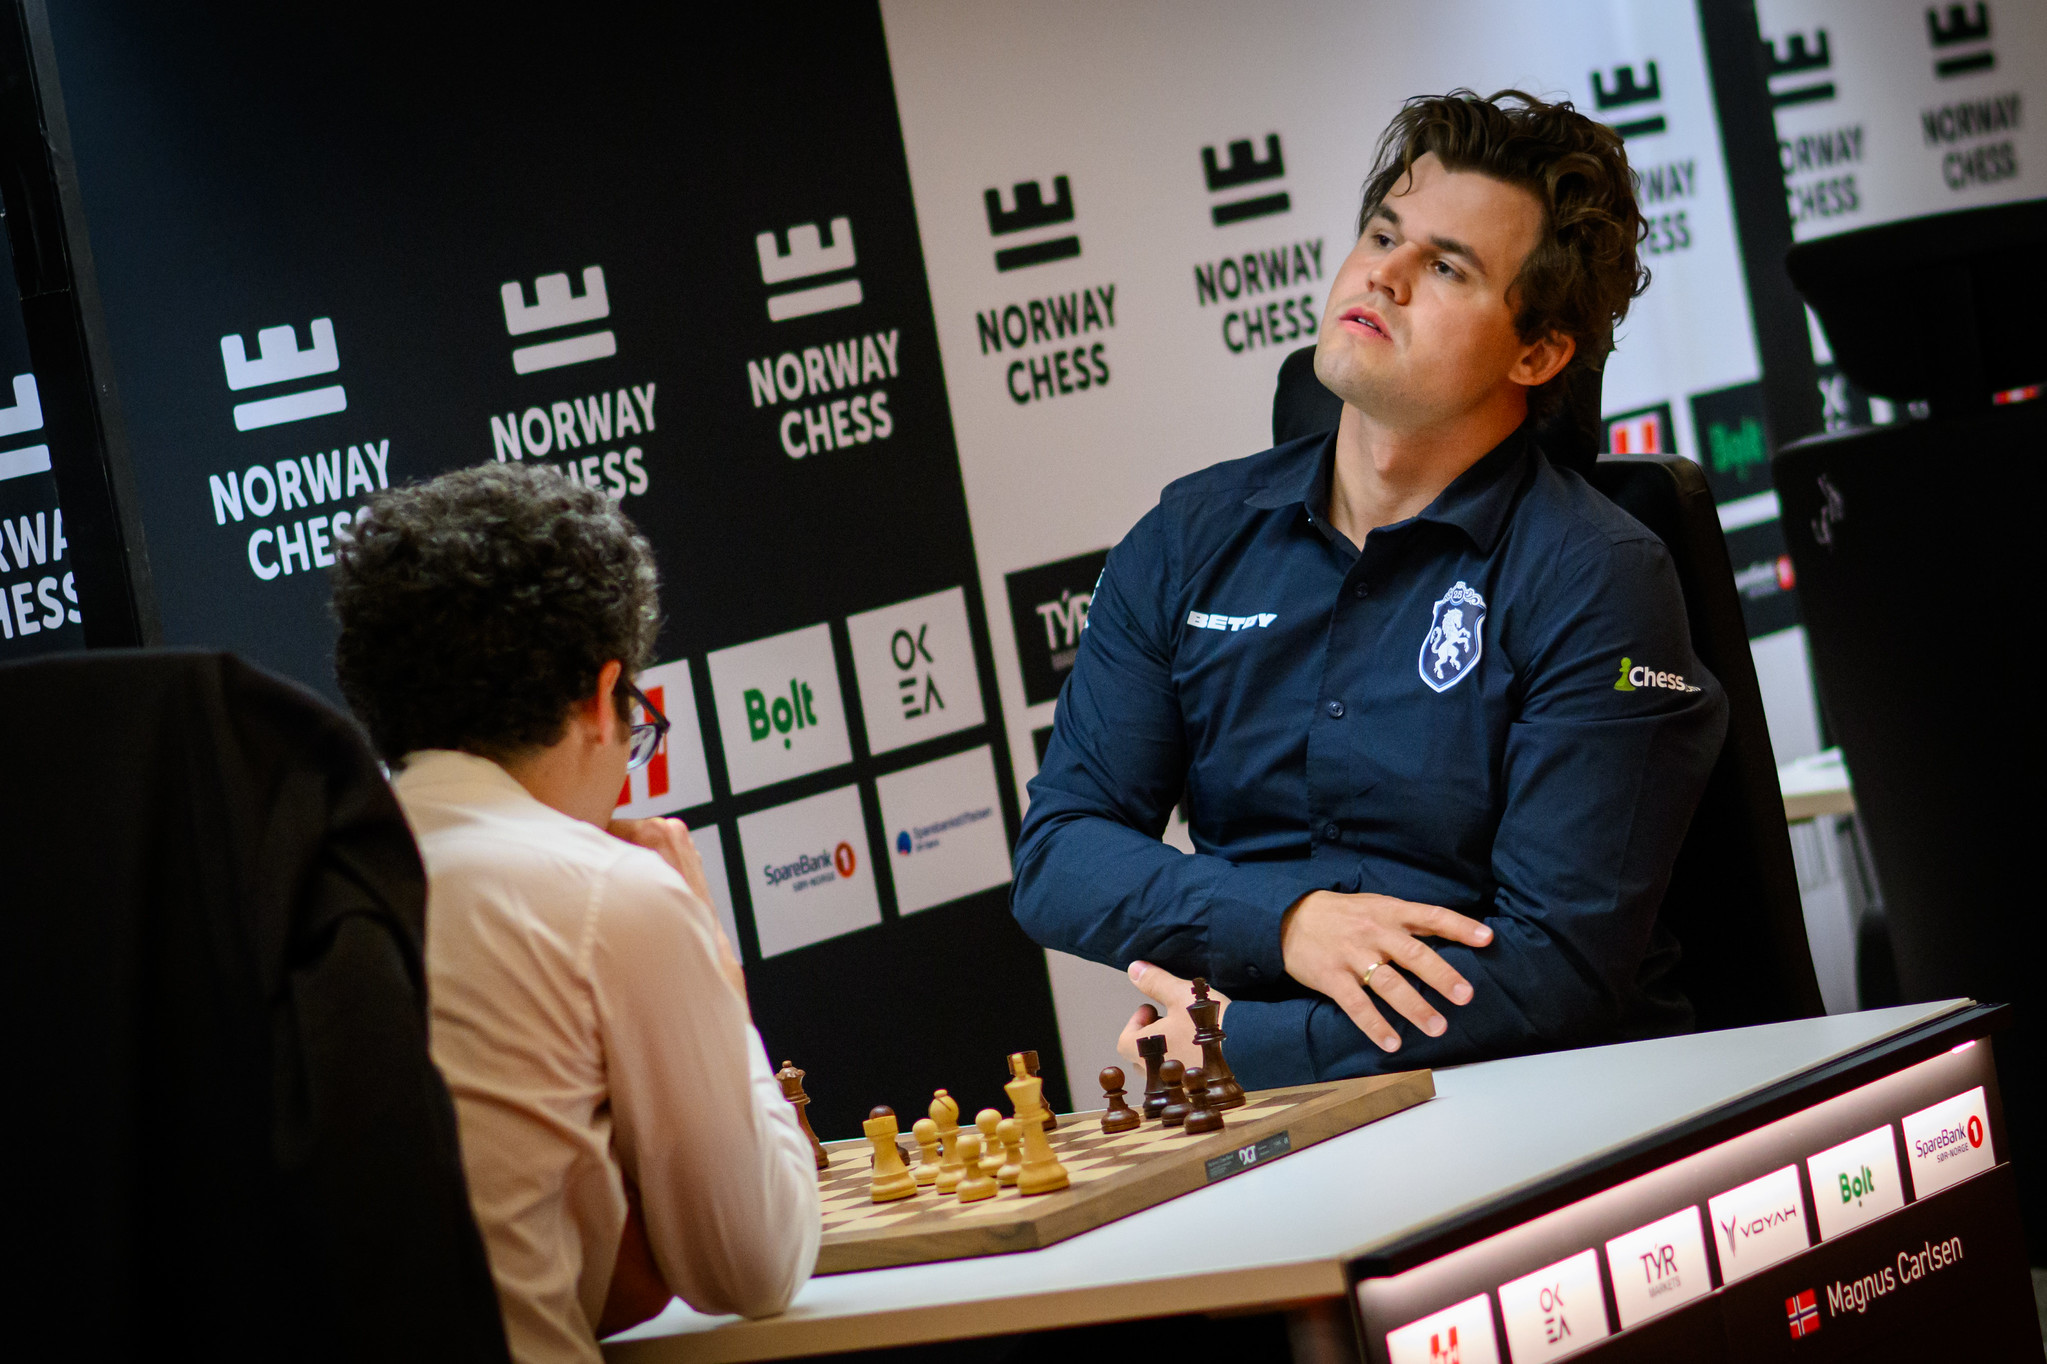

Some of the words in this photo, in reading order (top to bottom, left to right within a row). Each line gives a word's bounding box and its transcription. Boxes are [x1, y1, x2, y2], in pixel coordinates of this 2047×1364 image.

[1920, 92, 2021, 146] NORWAY
[1780, 124, 1864, 176] ORWAY
[1942, 141, 2018, 191] CHESS
[1787, 173, 1860, 226] HESS
[1194, 238, 1323, 307] NORWAY
[976, 283, 1116, 355] NORWAY
[1222, 294, 1318, 354] CHESS
[747, 328, 899, 408] NORWAY
[1007, 341, 1110, 405] CHESS
[490, 382, 656, 463] NORWAY
[780, 391, 893, 460] CHESS
[209, 439, 390, 526] NORWAY
[891, 623, 934, 671] OK
[743, 677, 818, 750] Bolt
[764, 848, 832, 886] SpareBank
[1915, 1121, 1967, 1158] SpareBank
[1936, 1142, 1969, 1163] SØR-NORGE
[1838, 1164, 1875, 1208] Bolt
[1740, 1204, 1797, 1238] VOYAH
[1639, 1243, 1678, 1284] TÝR
[1826, 1266, 1895, 1318] Magnus
[1897, 1236, 1963, 1284] Carlsen
[1540, 1282, 1564, 1313] OK
